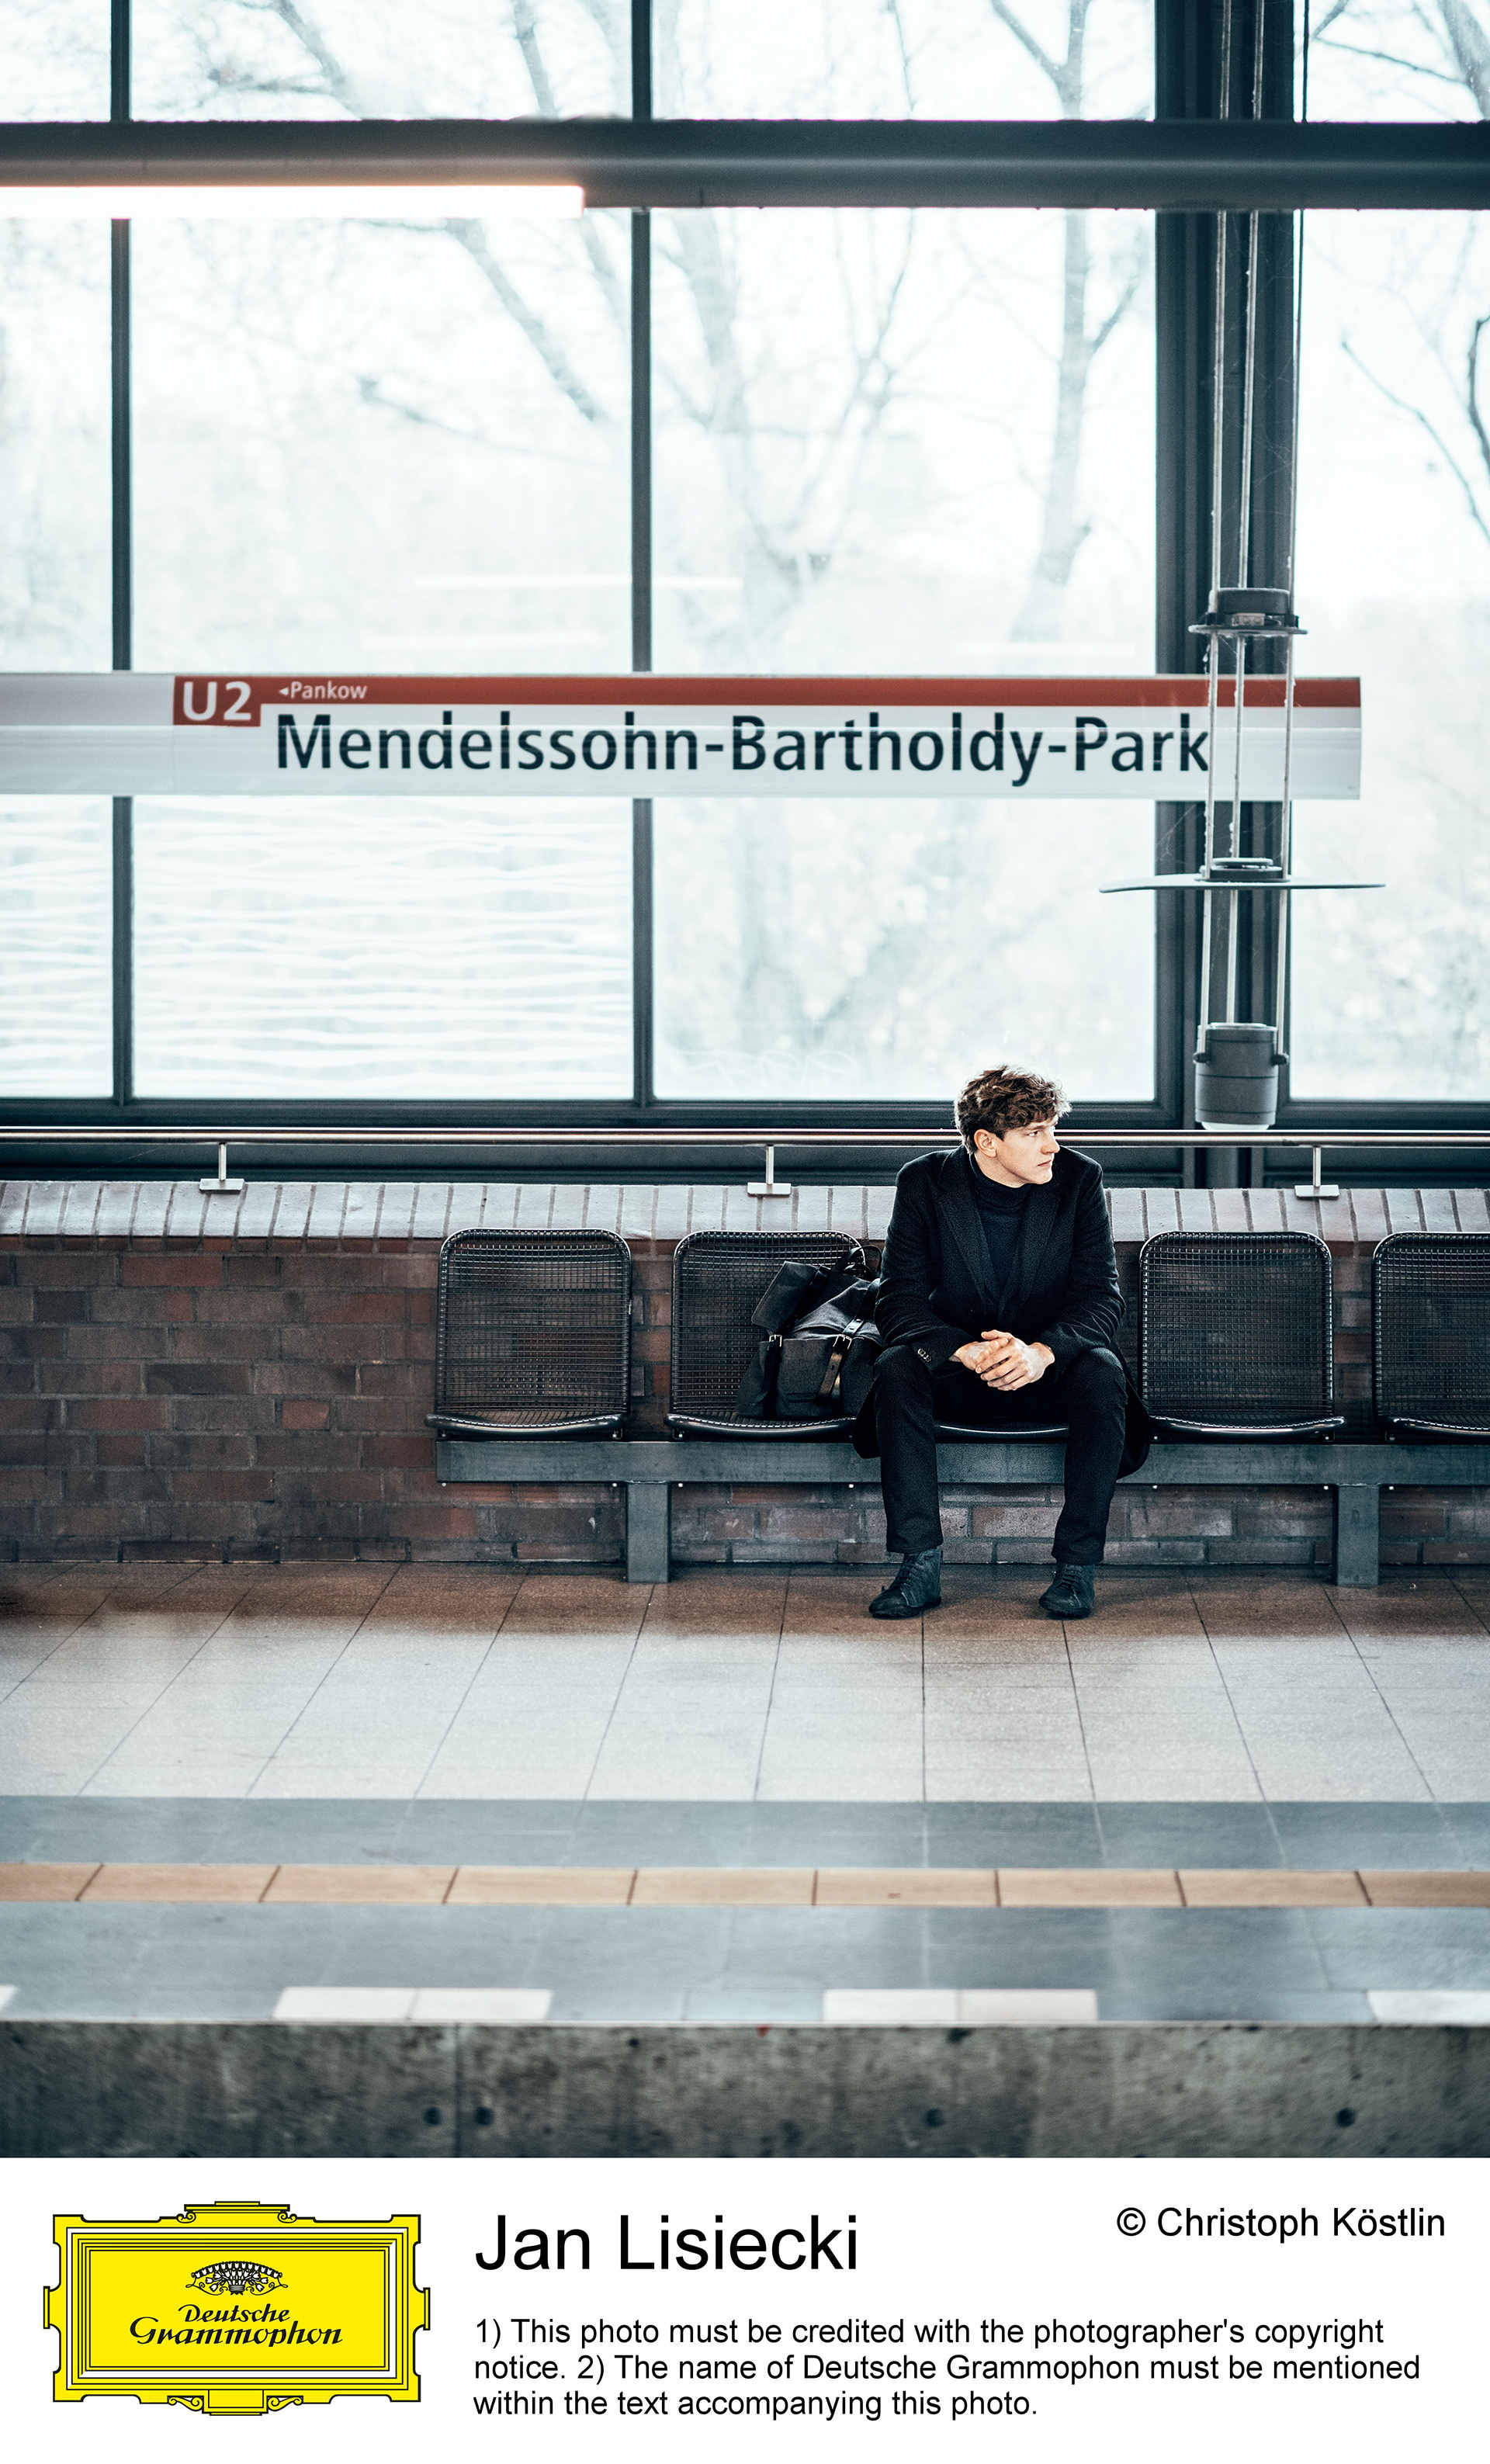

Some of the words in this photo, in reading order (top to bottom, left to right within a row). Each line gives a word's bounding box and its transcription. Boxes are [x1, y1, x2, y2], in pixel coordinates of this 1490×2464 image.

[183, 681, 251, 721] U2
[290, 680, 368, 699] Pankow
[277, 710, 1209, 787] Mendelssohn-Bartholdy-Park
